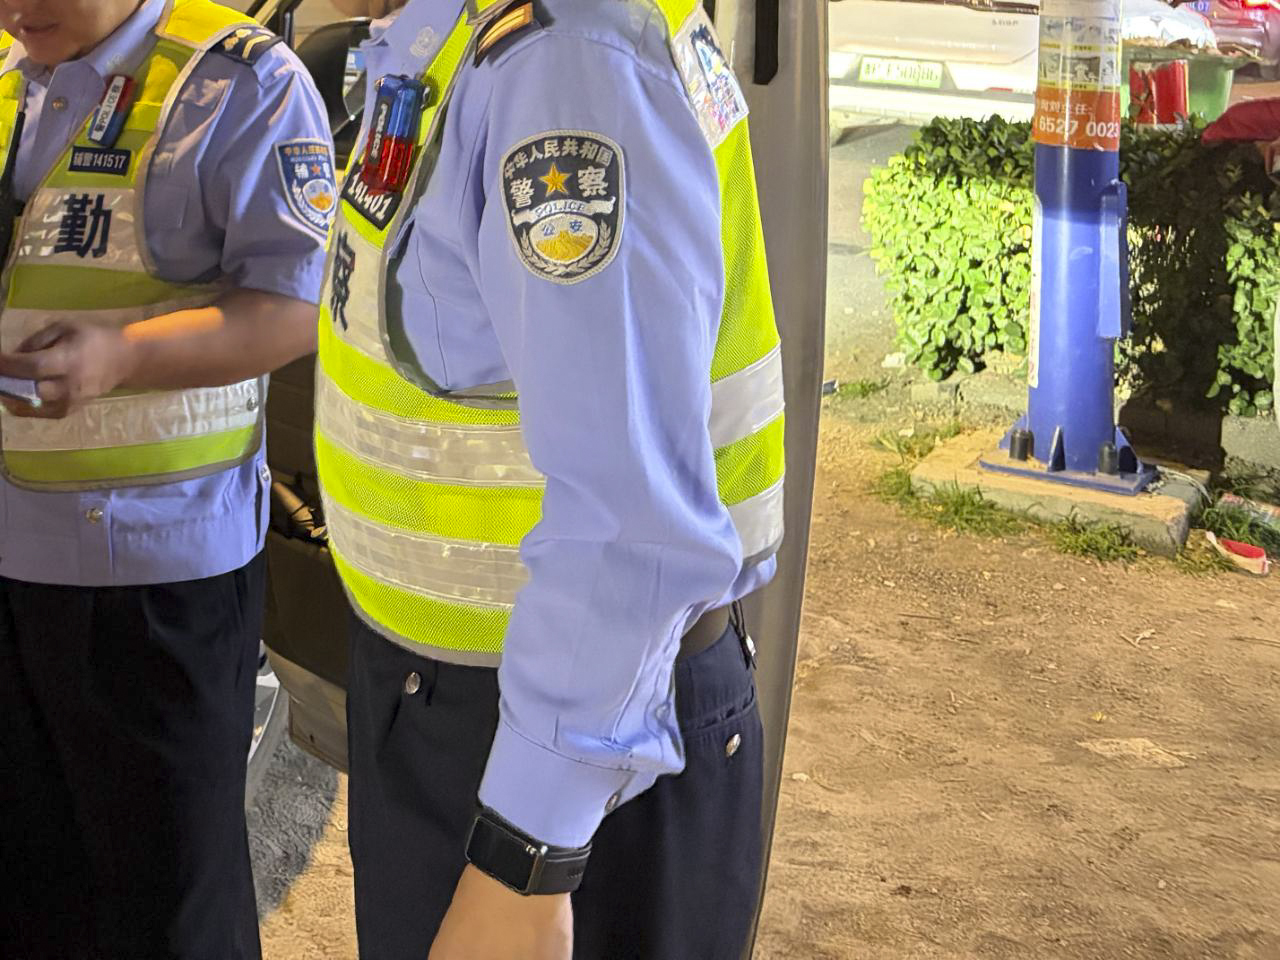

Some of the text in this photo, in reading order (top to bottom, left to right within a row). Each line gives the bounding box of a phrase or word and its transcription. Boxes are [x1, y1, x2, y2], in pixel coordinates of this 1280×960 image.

[504, 138, 613, 180] 中华人民共和国
[510, 166, 608, 208] 警 察
[54, 193, 112, 258] 勤
[535, 201, 586, 218] POLICE
